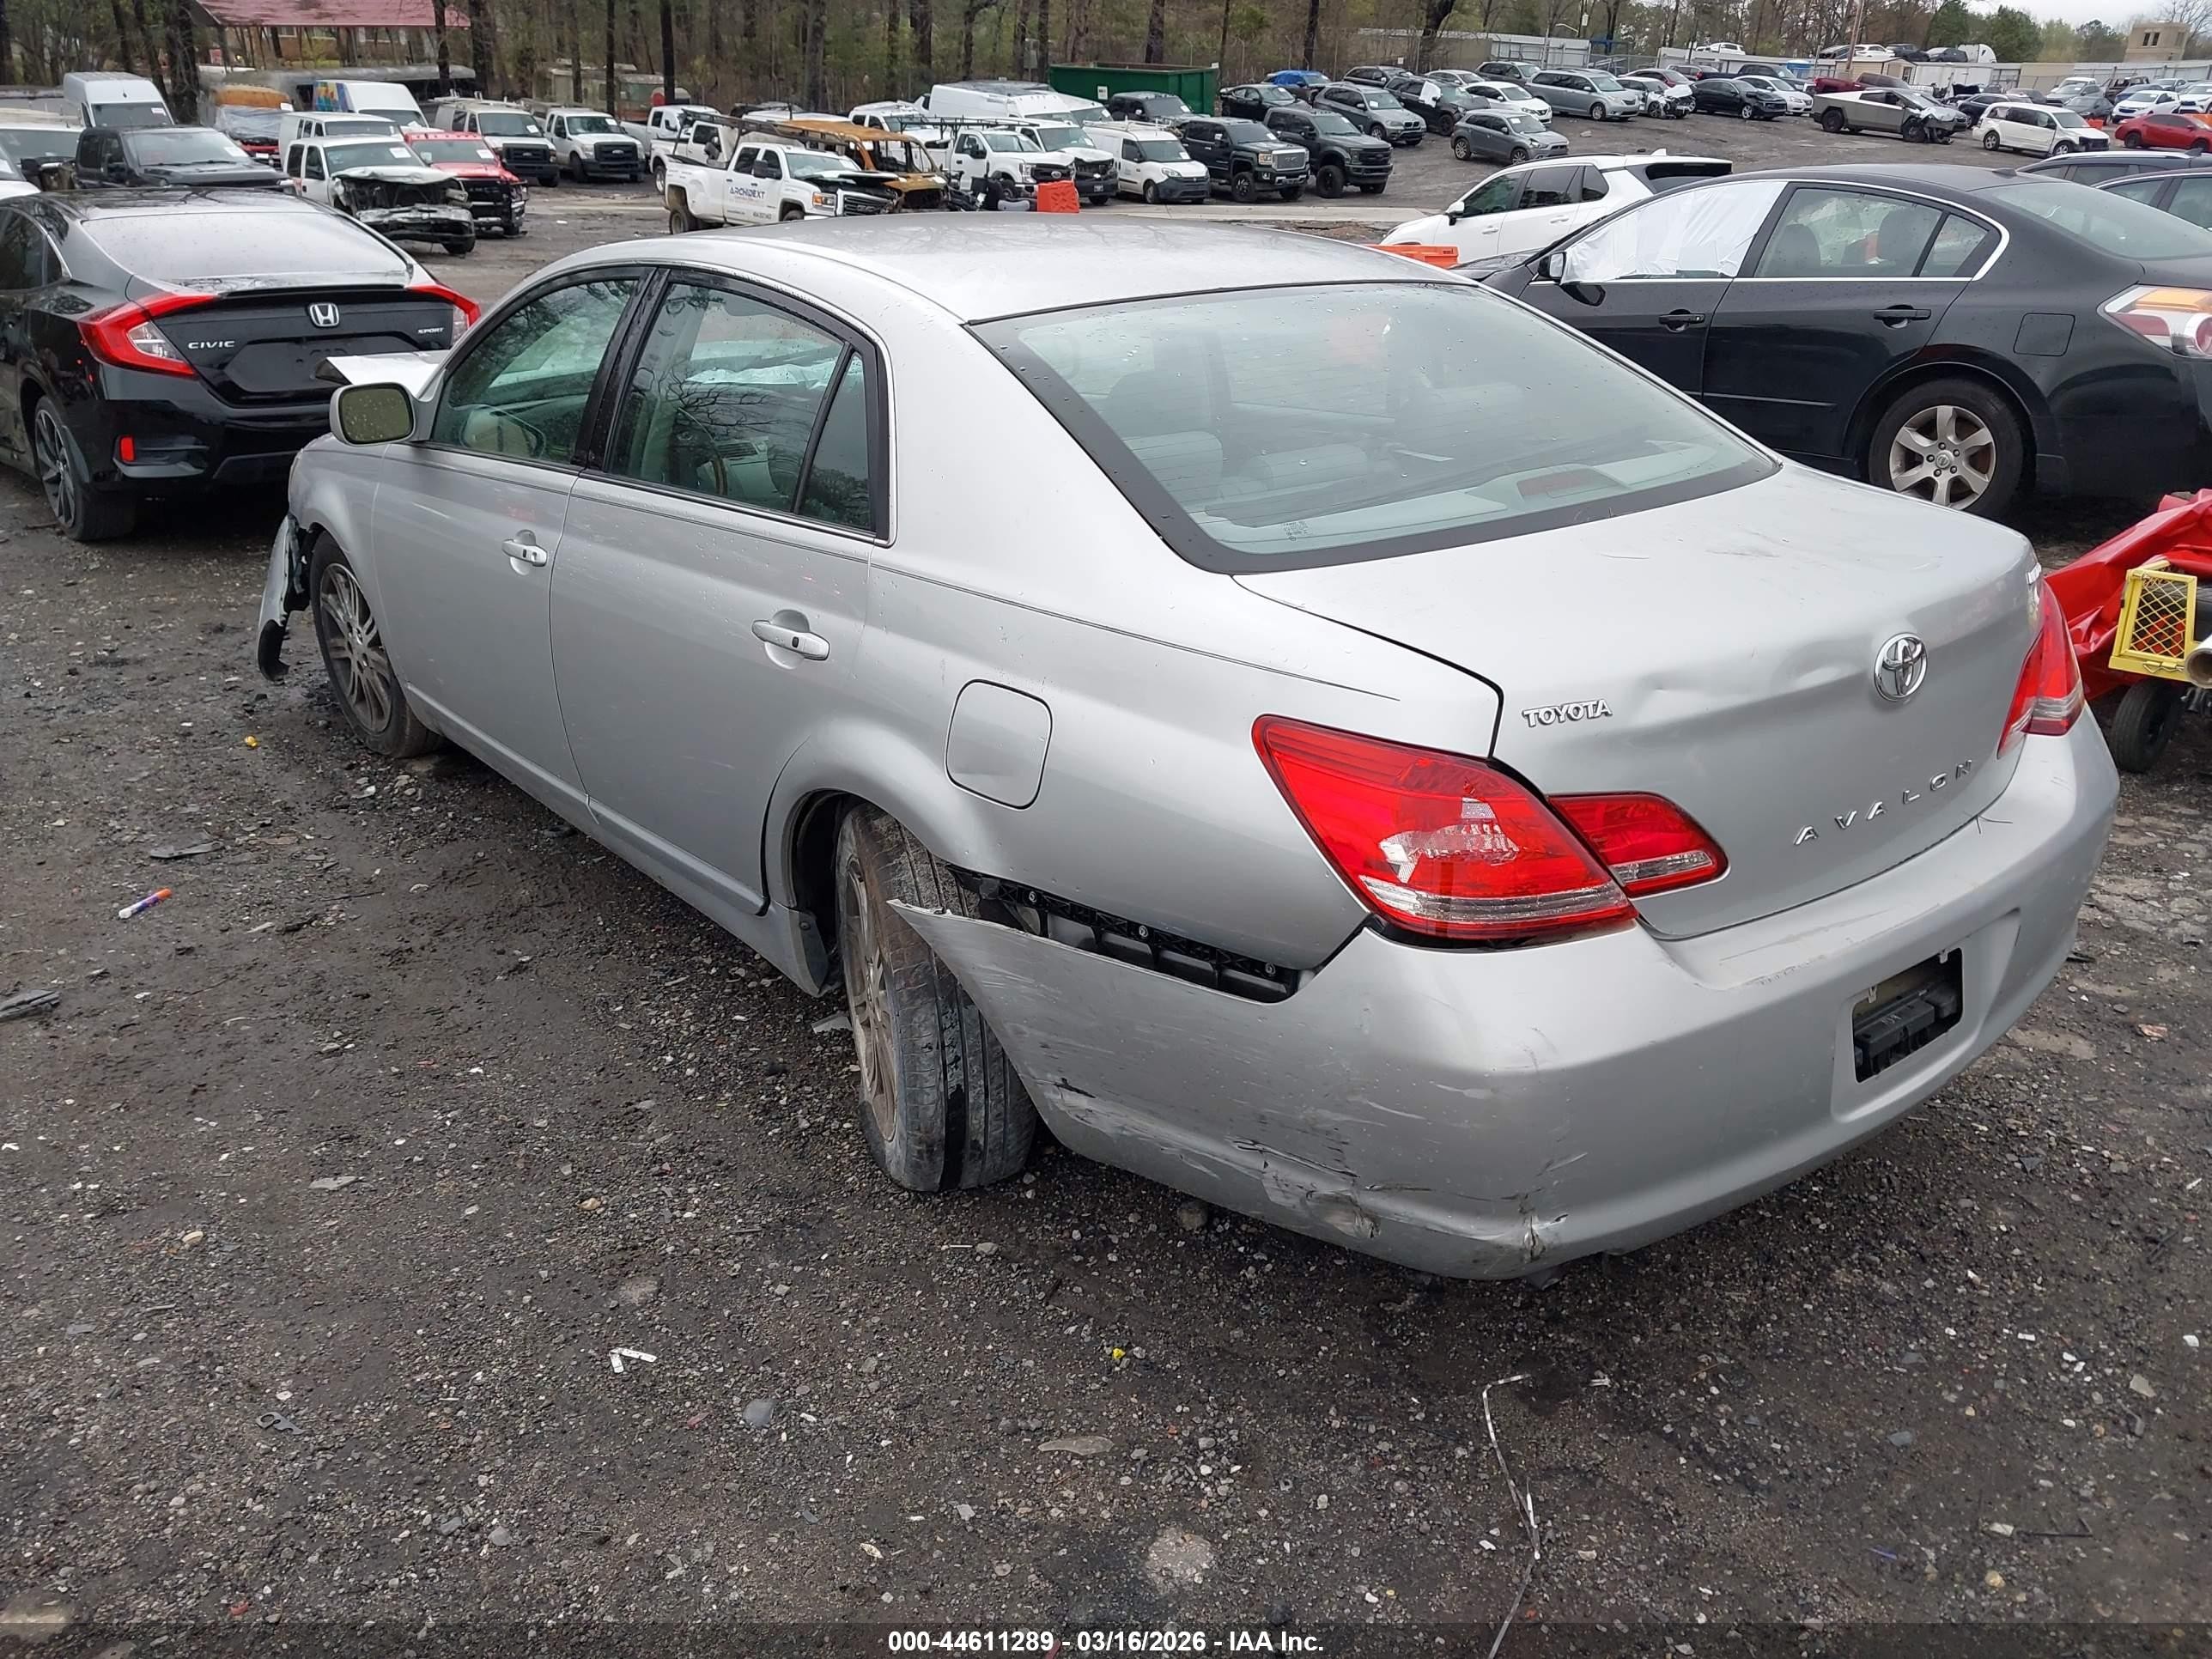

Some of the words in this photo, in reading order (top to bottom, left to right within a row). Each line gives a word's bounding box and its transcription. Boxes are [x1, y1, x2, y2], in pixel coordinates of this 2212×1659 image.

[417, 326, 445, 335] SPORT
[187, 340, 236, 349] CIVIC
[1522, 699, 1613, 728] TOYOTA
[1793, 759, 1973, 846] AVALON
